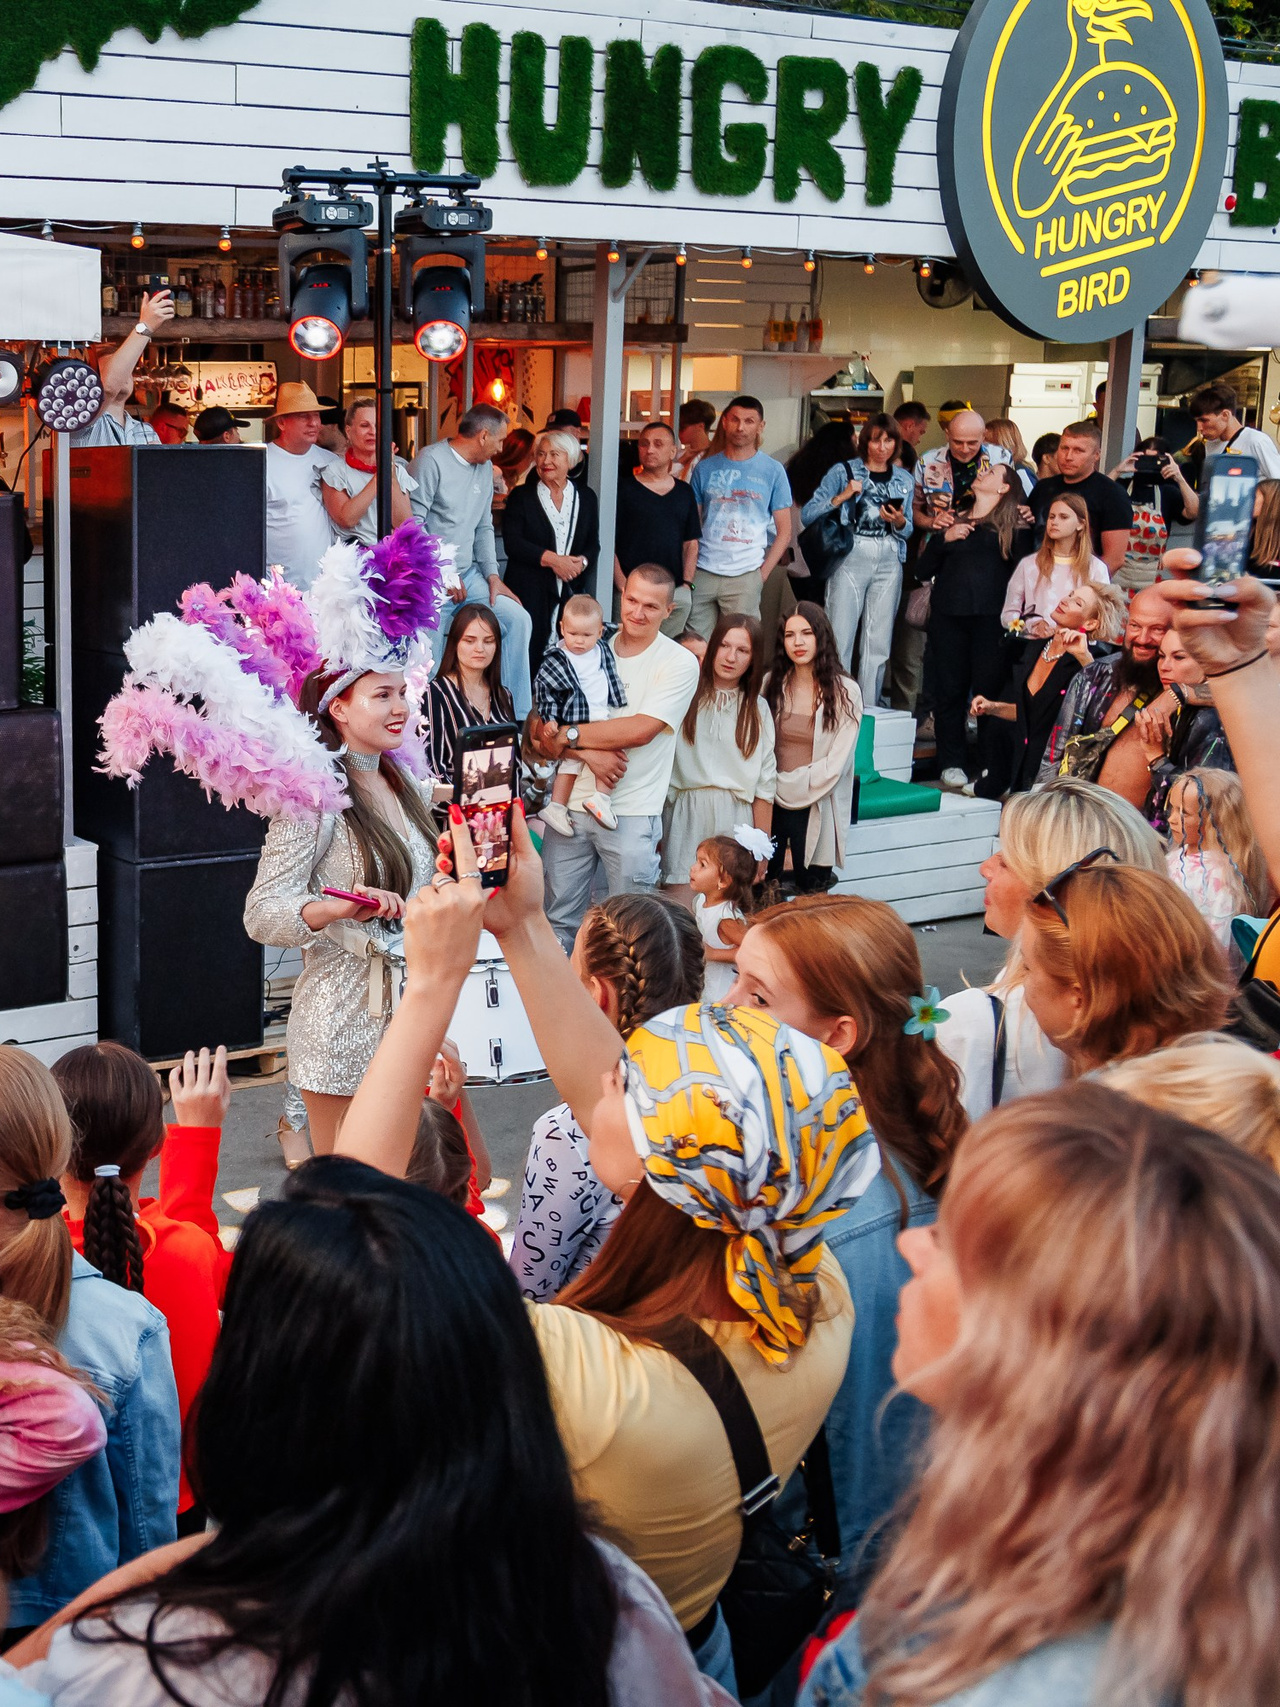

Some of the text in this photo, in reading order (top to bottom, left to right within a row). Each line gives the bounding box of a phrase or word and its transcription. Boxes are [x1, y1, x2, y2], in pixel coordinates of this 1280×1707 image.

[408, 16, 923, 207] HUNGRY
[1034, 190, 1167, 260] HUNGRY
[1056, 266, 1131, 319] BIRD
[545, 1157, 557, 1172] B
[523, 1231, 546, 1263] S
